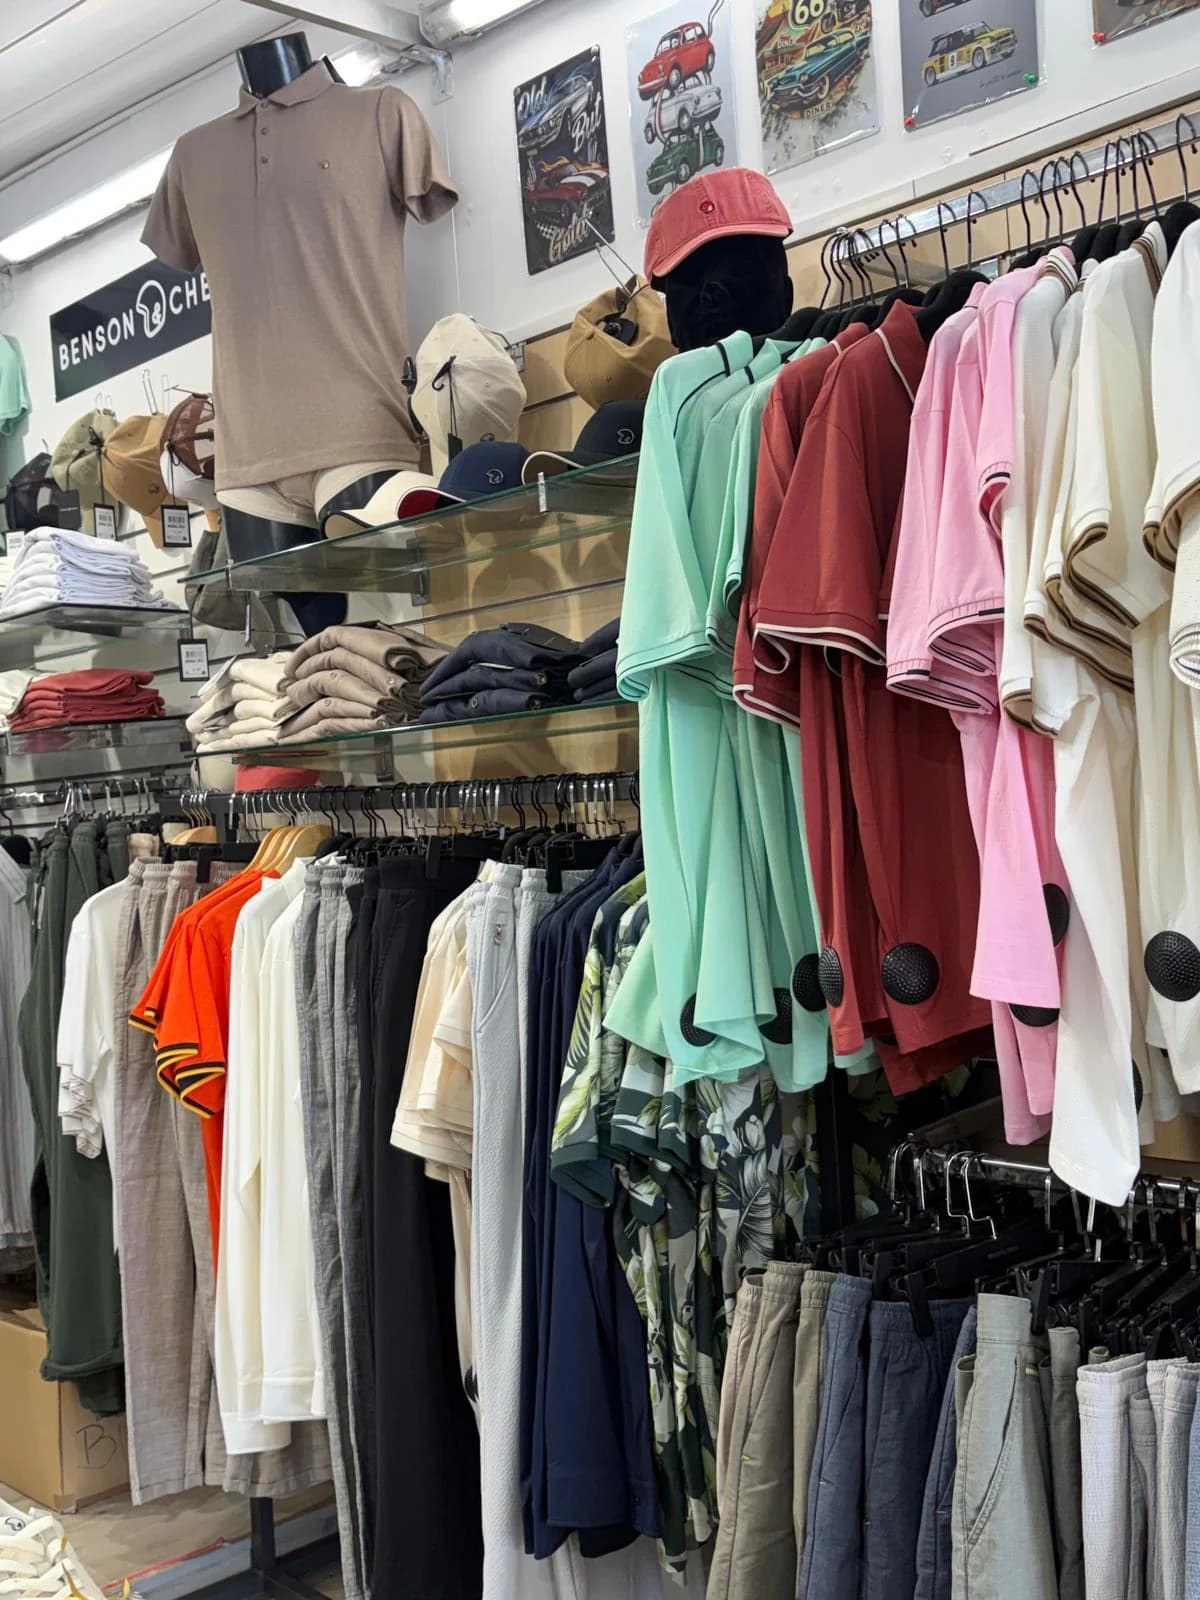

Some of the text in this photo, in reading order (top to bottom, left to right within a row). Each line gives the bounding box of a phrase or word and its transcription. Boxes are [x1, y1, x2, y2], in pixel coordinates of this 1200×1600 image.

[517, 76, 548, 119] Old
[572, 92, 602, 153] But
[59, 309, 136, 371] BENSON
